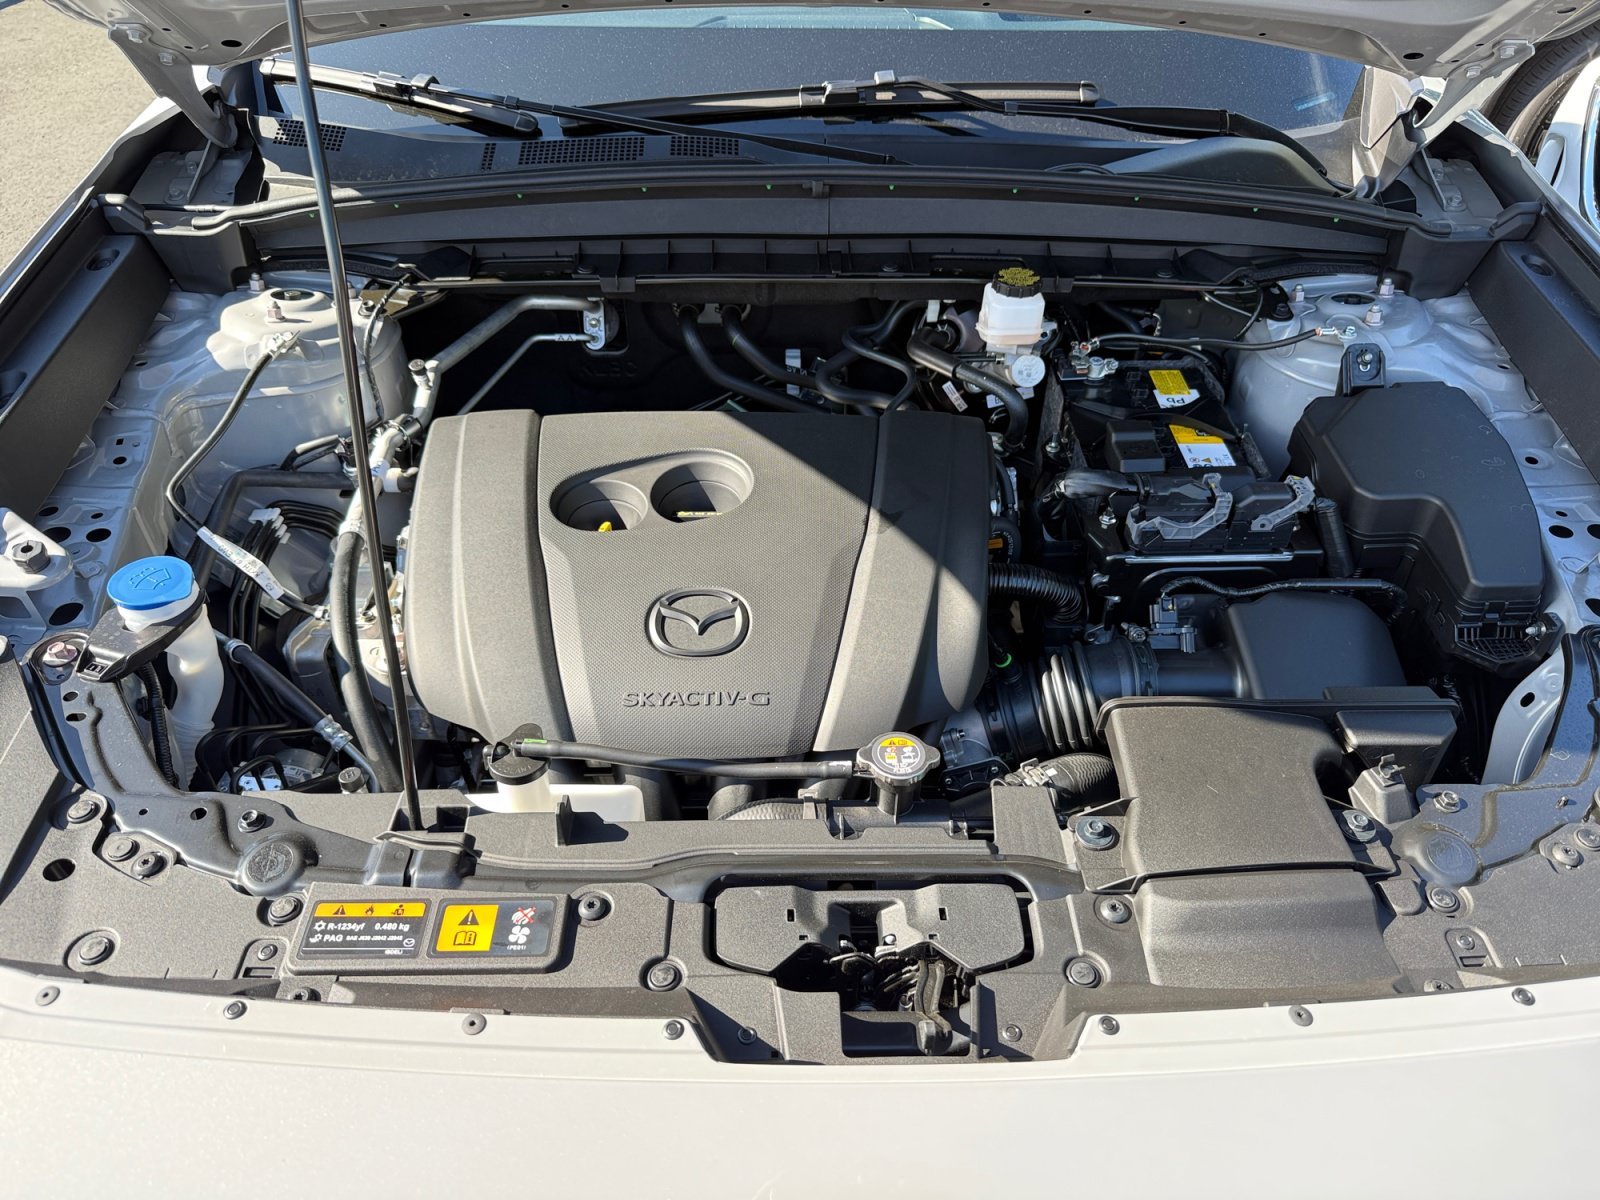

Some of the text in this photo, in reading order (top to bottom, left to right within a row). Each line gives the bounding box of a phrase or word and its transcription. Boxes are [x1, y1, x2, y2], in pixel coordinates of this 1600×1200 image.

[622, 691, 771, 708] SKYACTIV-G
[326, 922, 366, 932] R-1234yf
[398, 922, 410, 932] kg
[323, 934, 343, 942] PAG
